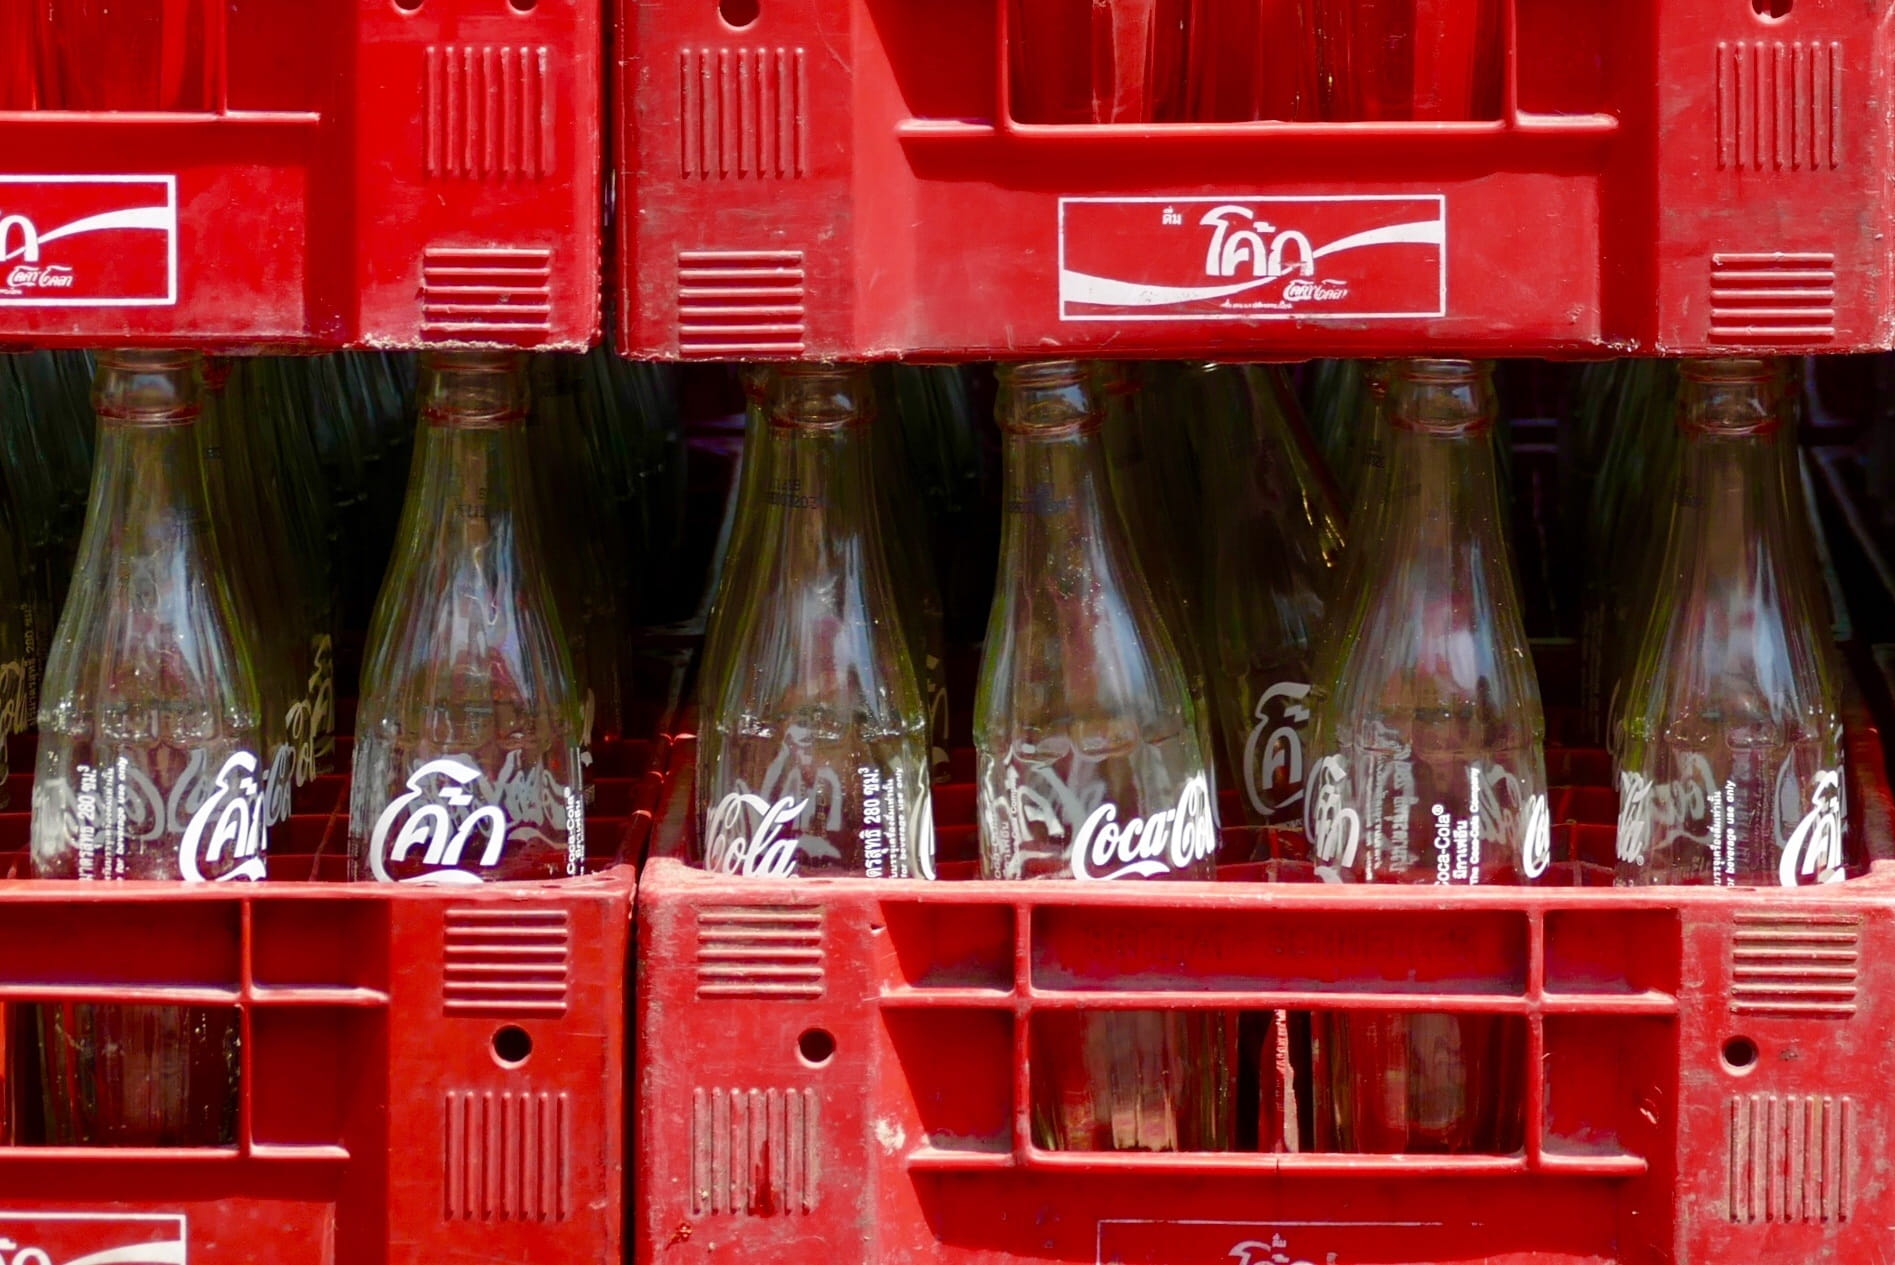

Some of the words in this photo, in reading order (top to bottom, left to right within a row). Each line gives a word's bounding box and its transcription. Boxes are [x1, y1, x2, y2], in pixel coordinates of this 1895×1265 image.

[1200, 205, 1314, 277] โค้ก
[116, 756, 128, 781] only
[894, 766, 904, 789] only
[116, 784, 126, 803] use
[894, 792, 904, 811] use
[1469, 767, 1480, 813] Company
[1725, 779, 1736, 803] only
[78, 795, 95, 820] 280
[863, 798, 881, 824] 280
[1726, 805, 1735, 825] use
[116, 806, 126, 855] beverage
[896, 814, 907, 861] beverage
[1469, 815, 1480, 865] Coca-Cola
[1725, 828, 1737, 874] beverage
[116, 858, 125, 873] for
[898, 864, 907, 878] for
[1469, 867, 1480, 884] The
